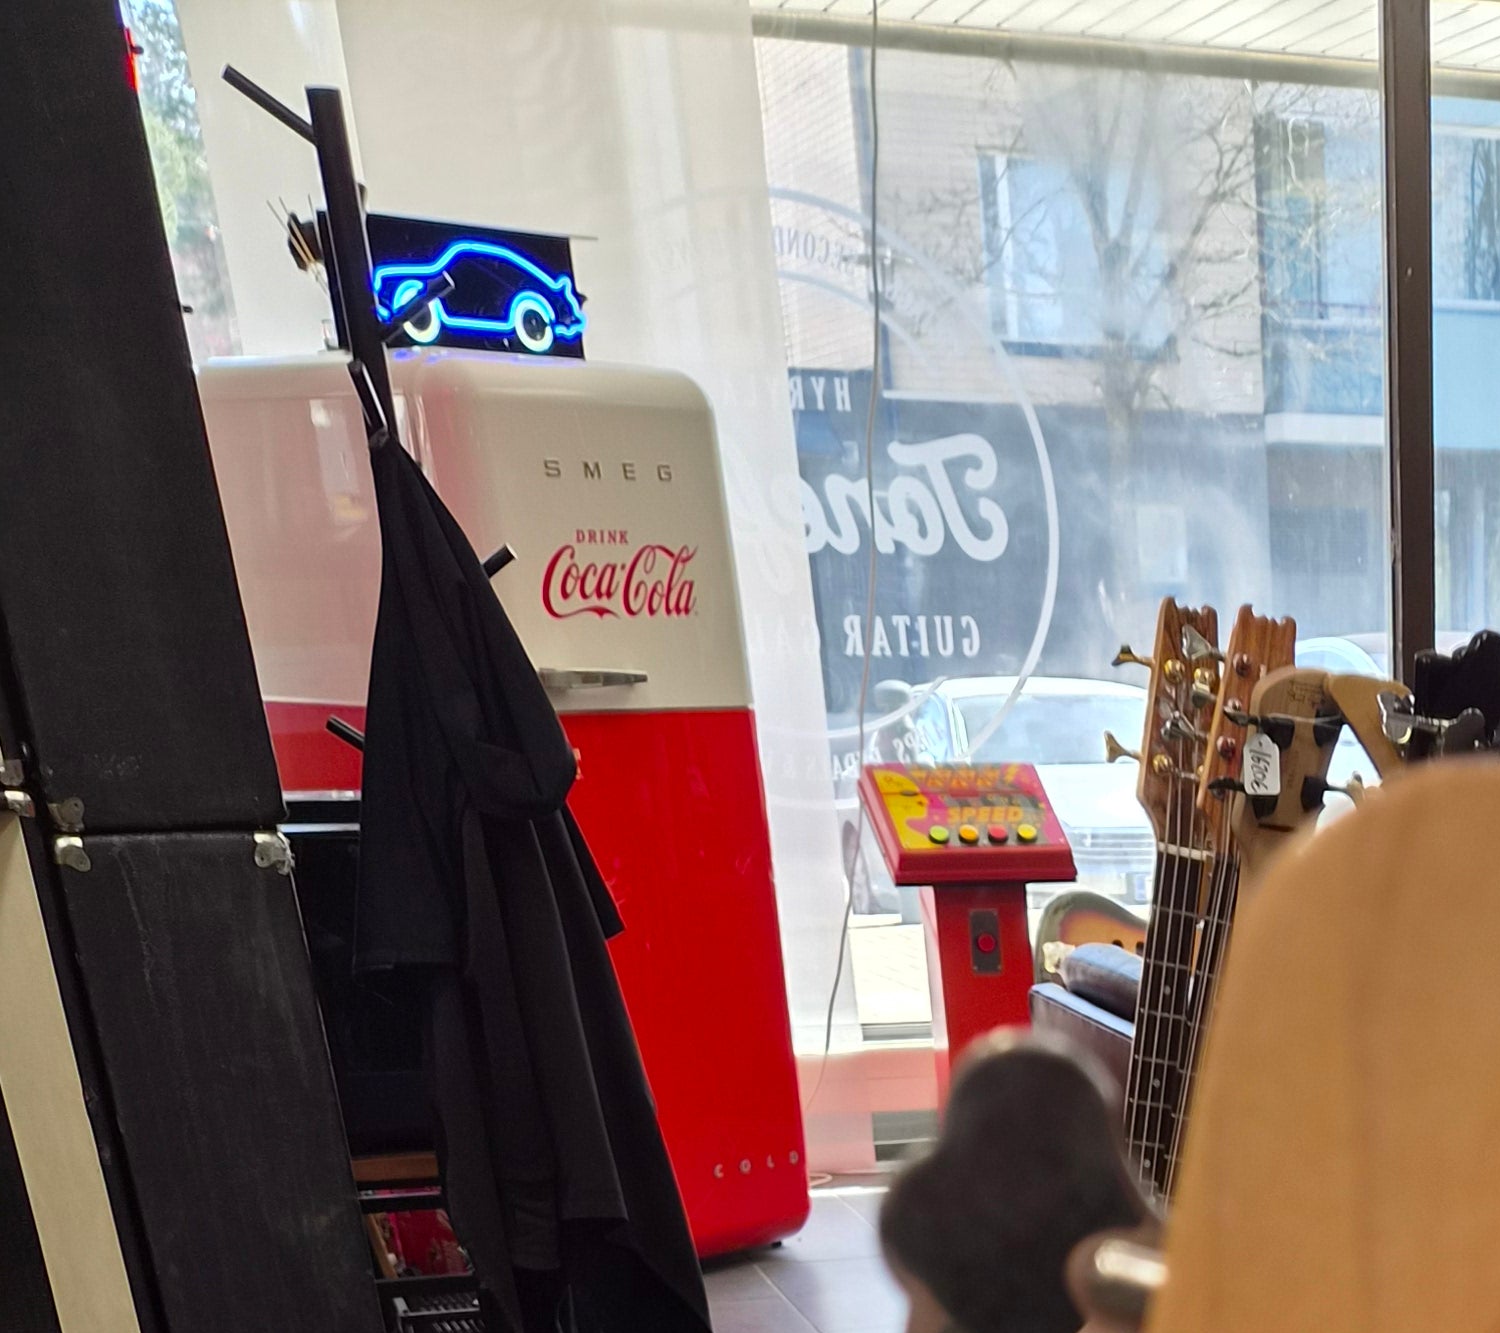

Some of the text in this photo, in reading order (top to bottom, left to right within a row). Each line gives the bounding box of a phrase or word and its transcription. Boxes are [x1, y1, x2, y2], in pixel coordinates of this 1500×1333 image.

[543, 460, 673, 482] SMEG
[575, 529, 629, 544] DRINK
[541, 544, 698, 620] Coca-Cola
